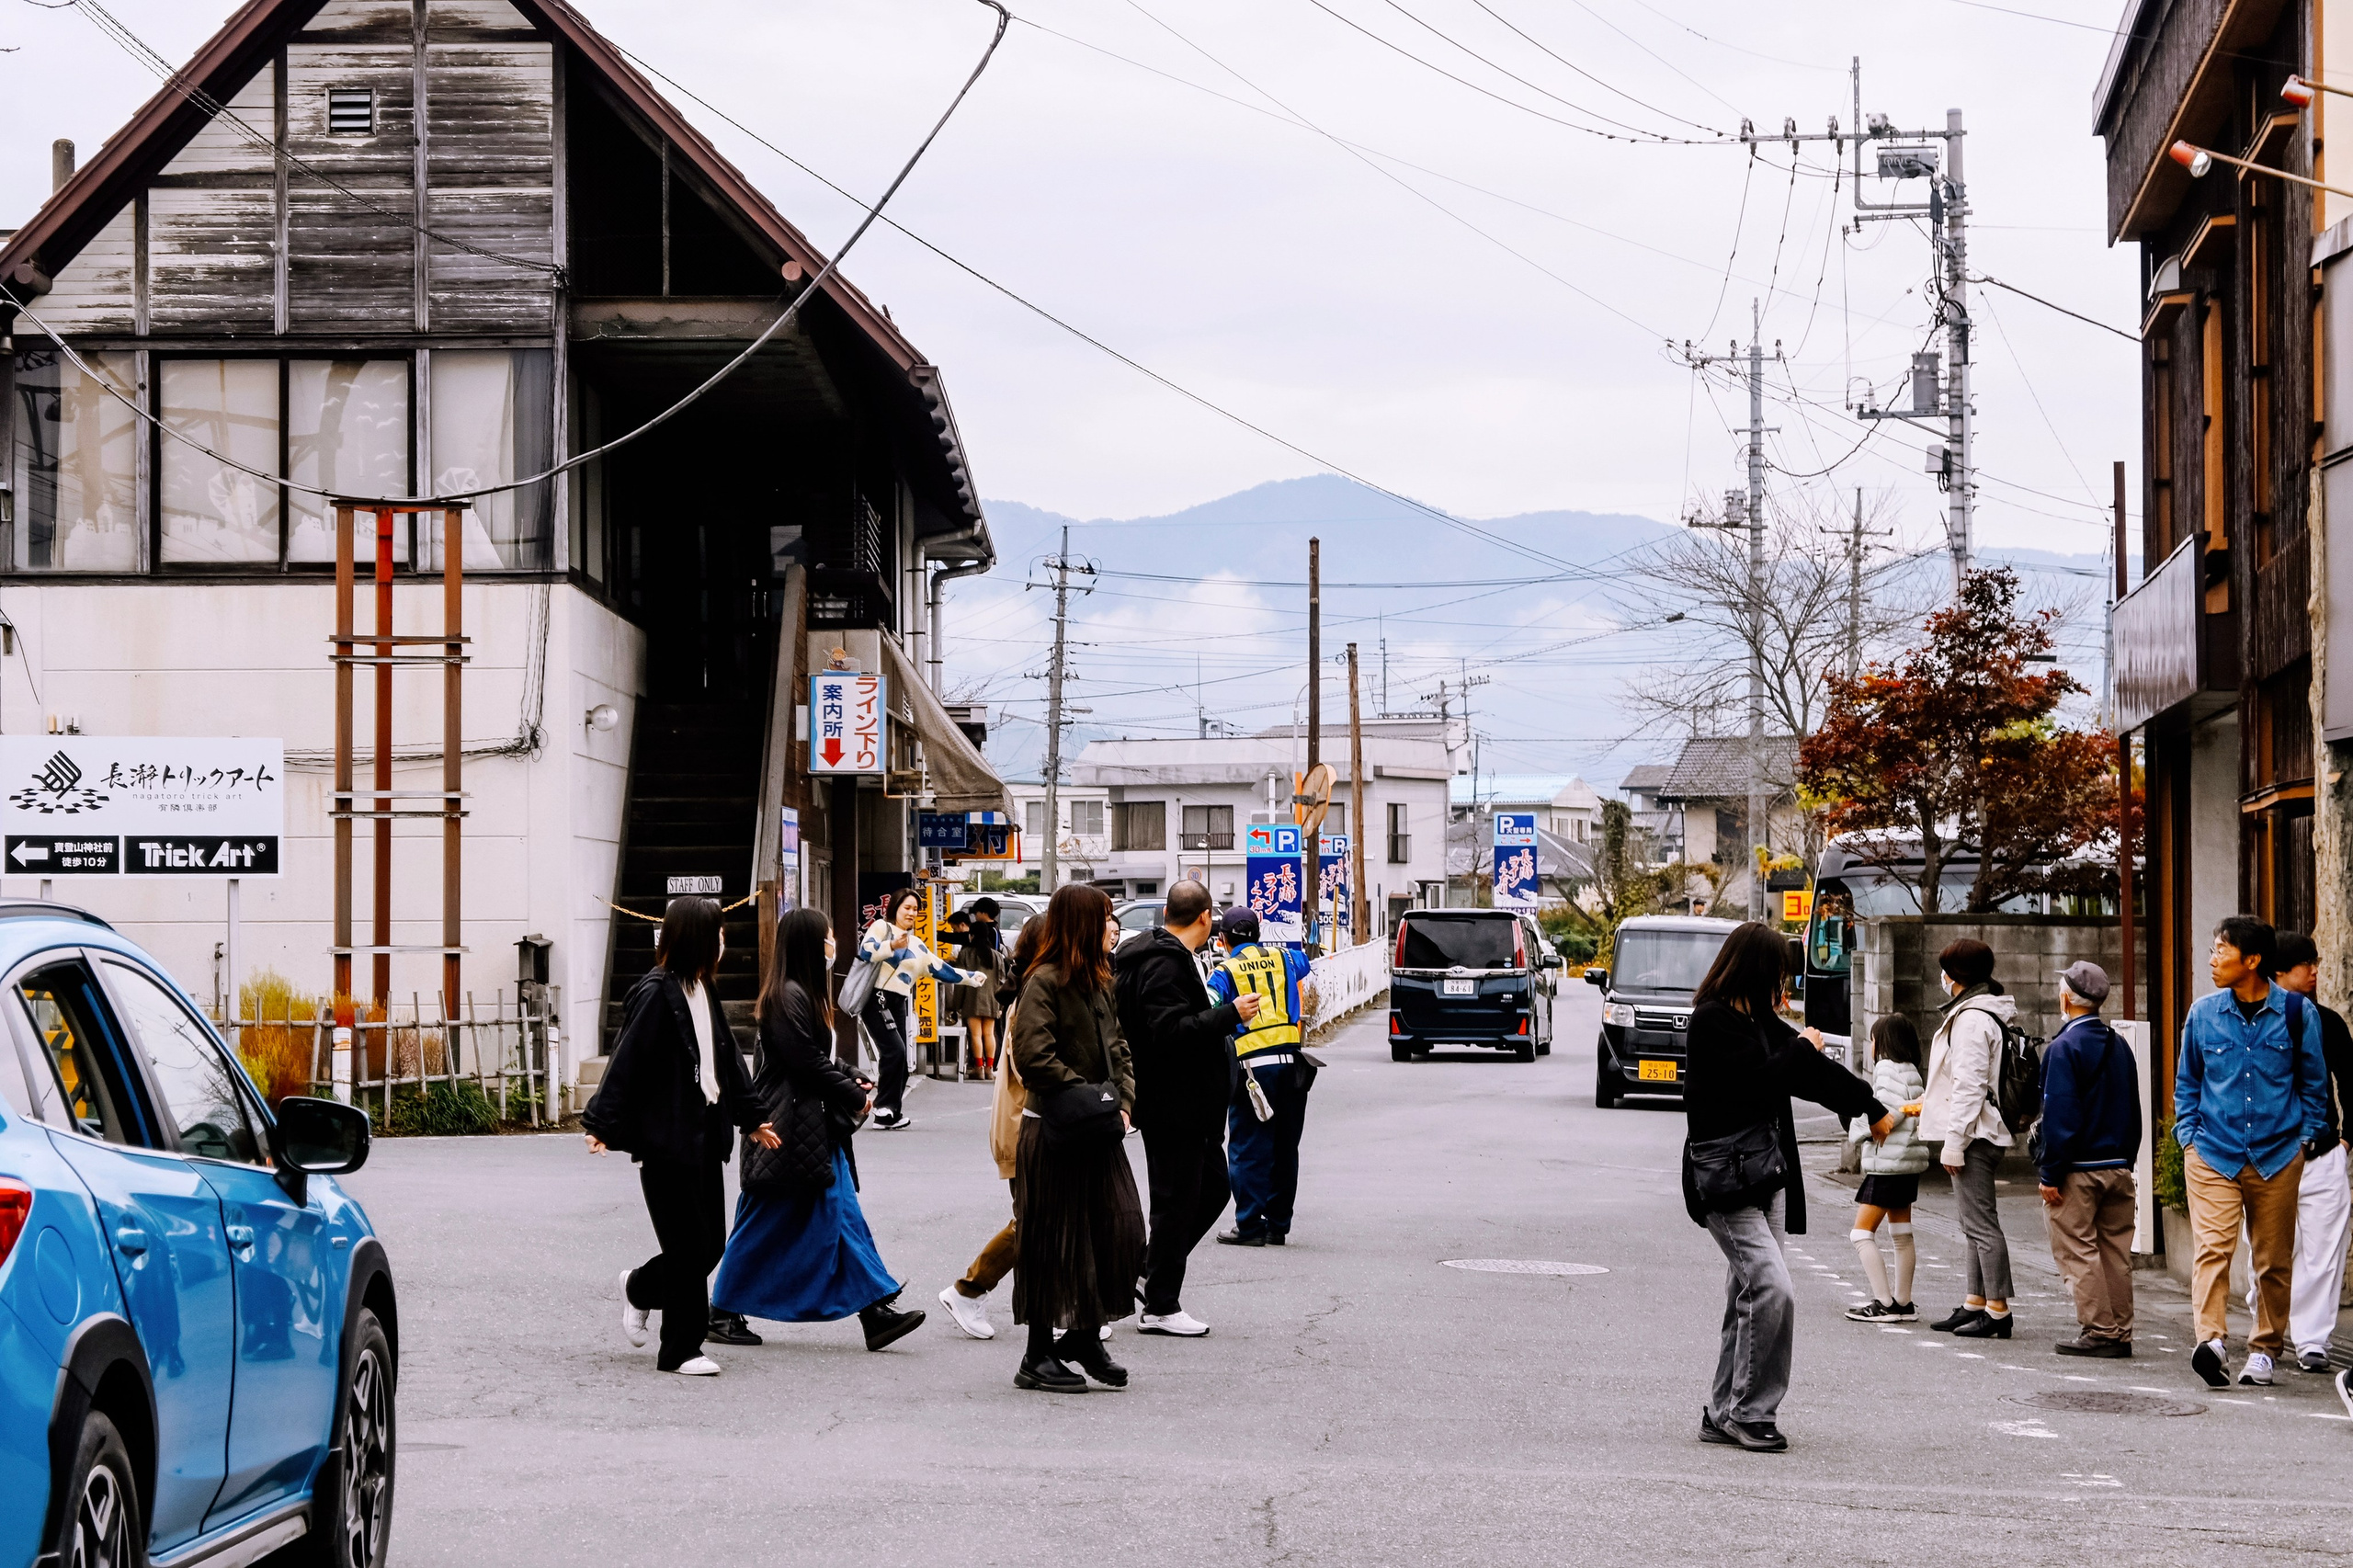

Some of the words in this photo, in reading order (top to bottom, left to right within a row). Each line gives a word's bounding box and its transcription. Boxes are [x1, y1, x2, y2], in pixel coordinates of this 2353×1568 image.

[822, 684, 844, 738] 案内所
[853, 676, 879, 770] ライン下り
[99, 761, 275, 792] 長瀞トリックアート
[132, 792, 185, 801] nagatoro
[922, 826, 962, 837] 待合室
[1499, 816, 1515, 834] P
[1278, 831, 1295, 851] P
[62, 857, 108, 868] 徒歩10分
[139, 842, 206, 867] Trick
[668, 878, 693, 892] STAFF
[698, 877, 720, 892] ONLY
[1263, 872, 1279, 915] ライン
[1239, 960, 1276, 972] UNION
[1646, 1068, 1675, 1079] 25-10
